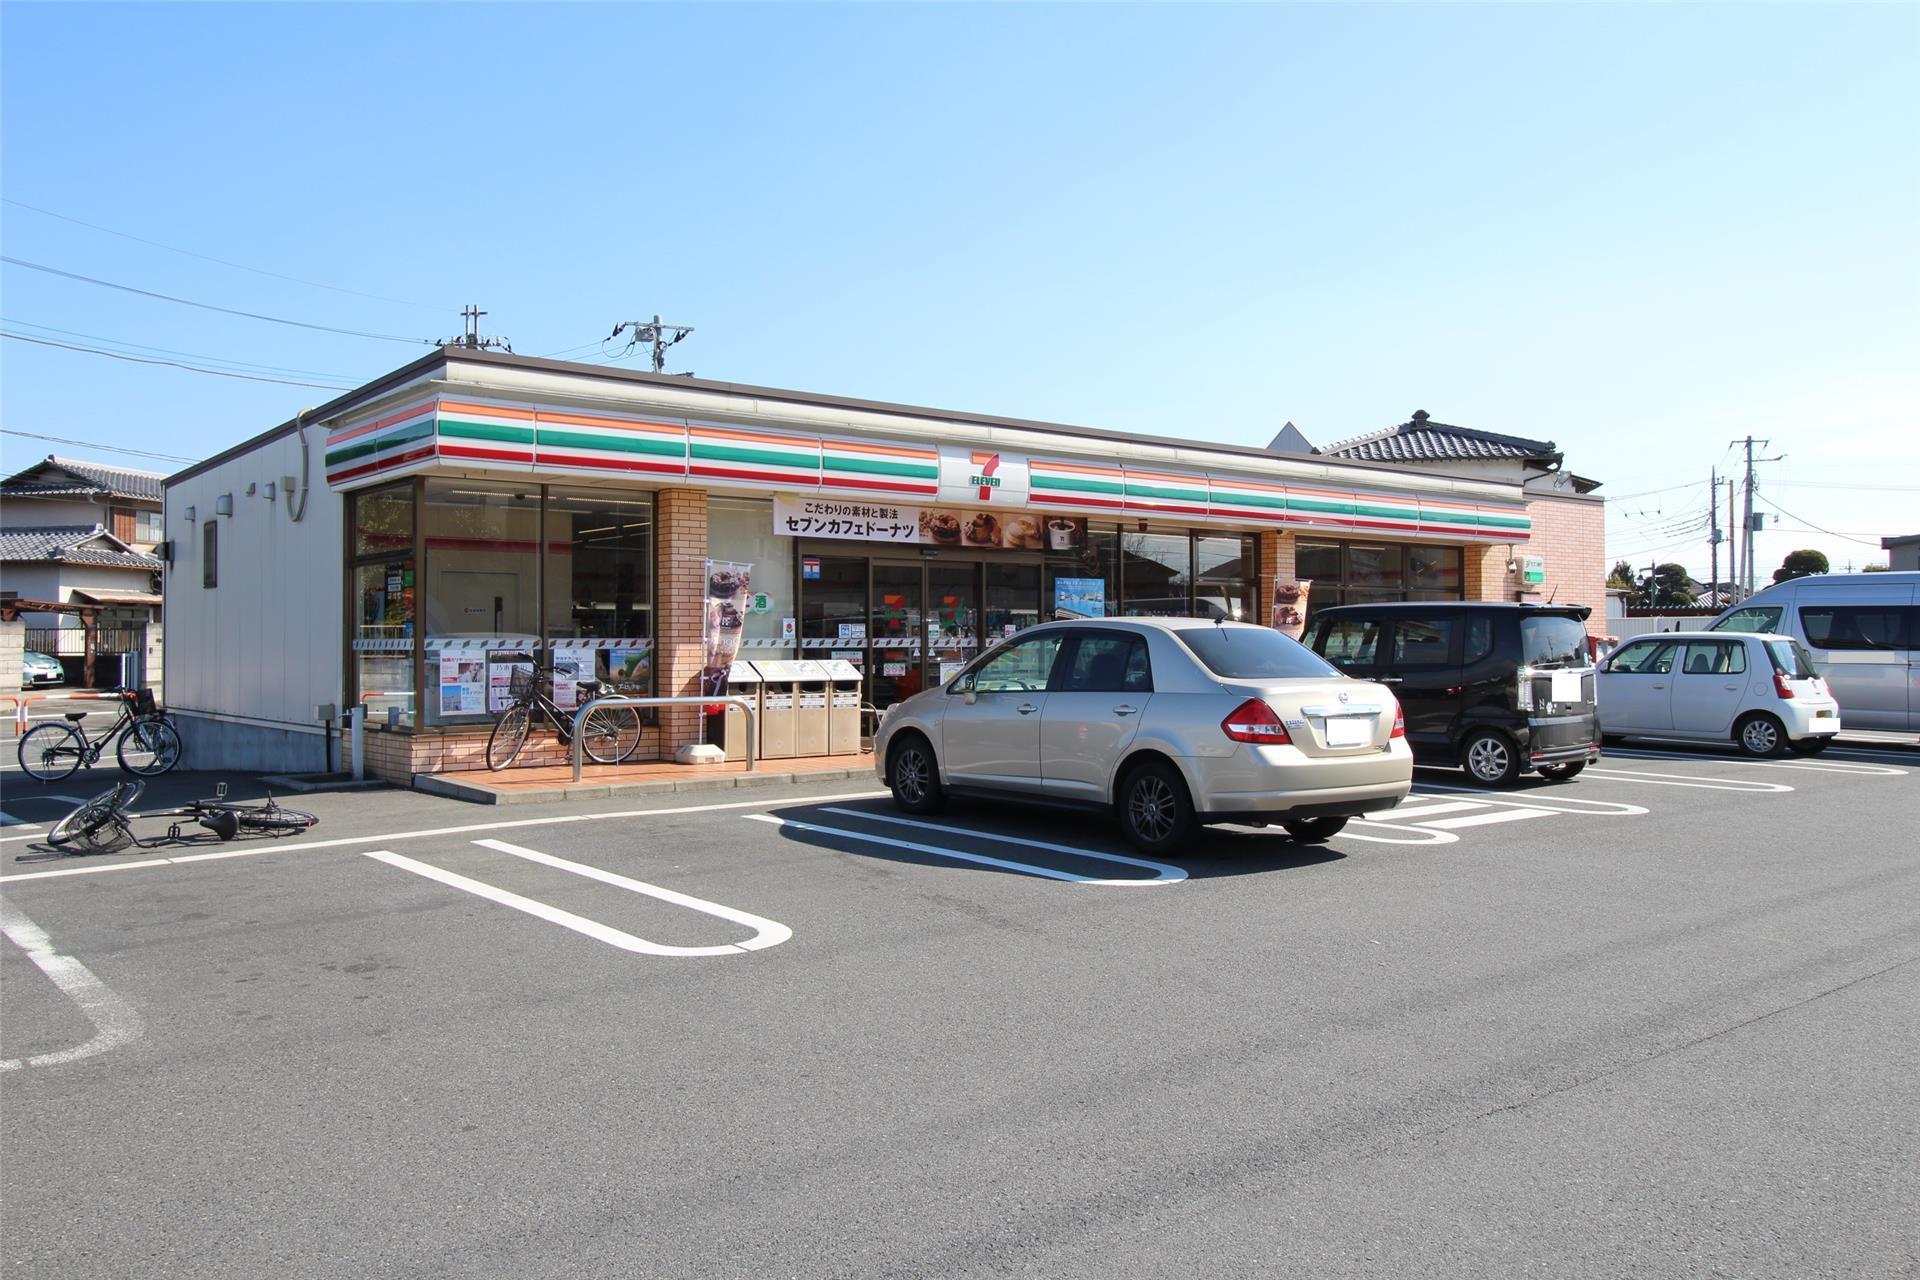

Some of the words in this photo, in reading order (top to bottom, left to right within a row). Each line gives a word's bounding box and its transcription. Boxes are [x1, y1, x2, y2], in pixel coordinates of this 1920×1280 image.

[805, 502, 899, 519] こだわりの素材と製法
[786, 516, 915, 538] セブンカフェドーナツ
[755, 594, 768, 609] 酒
